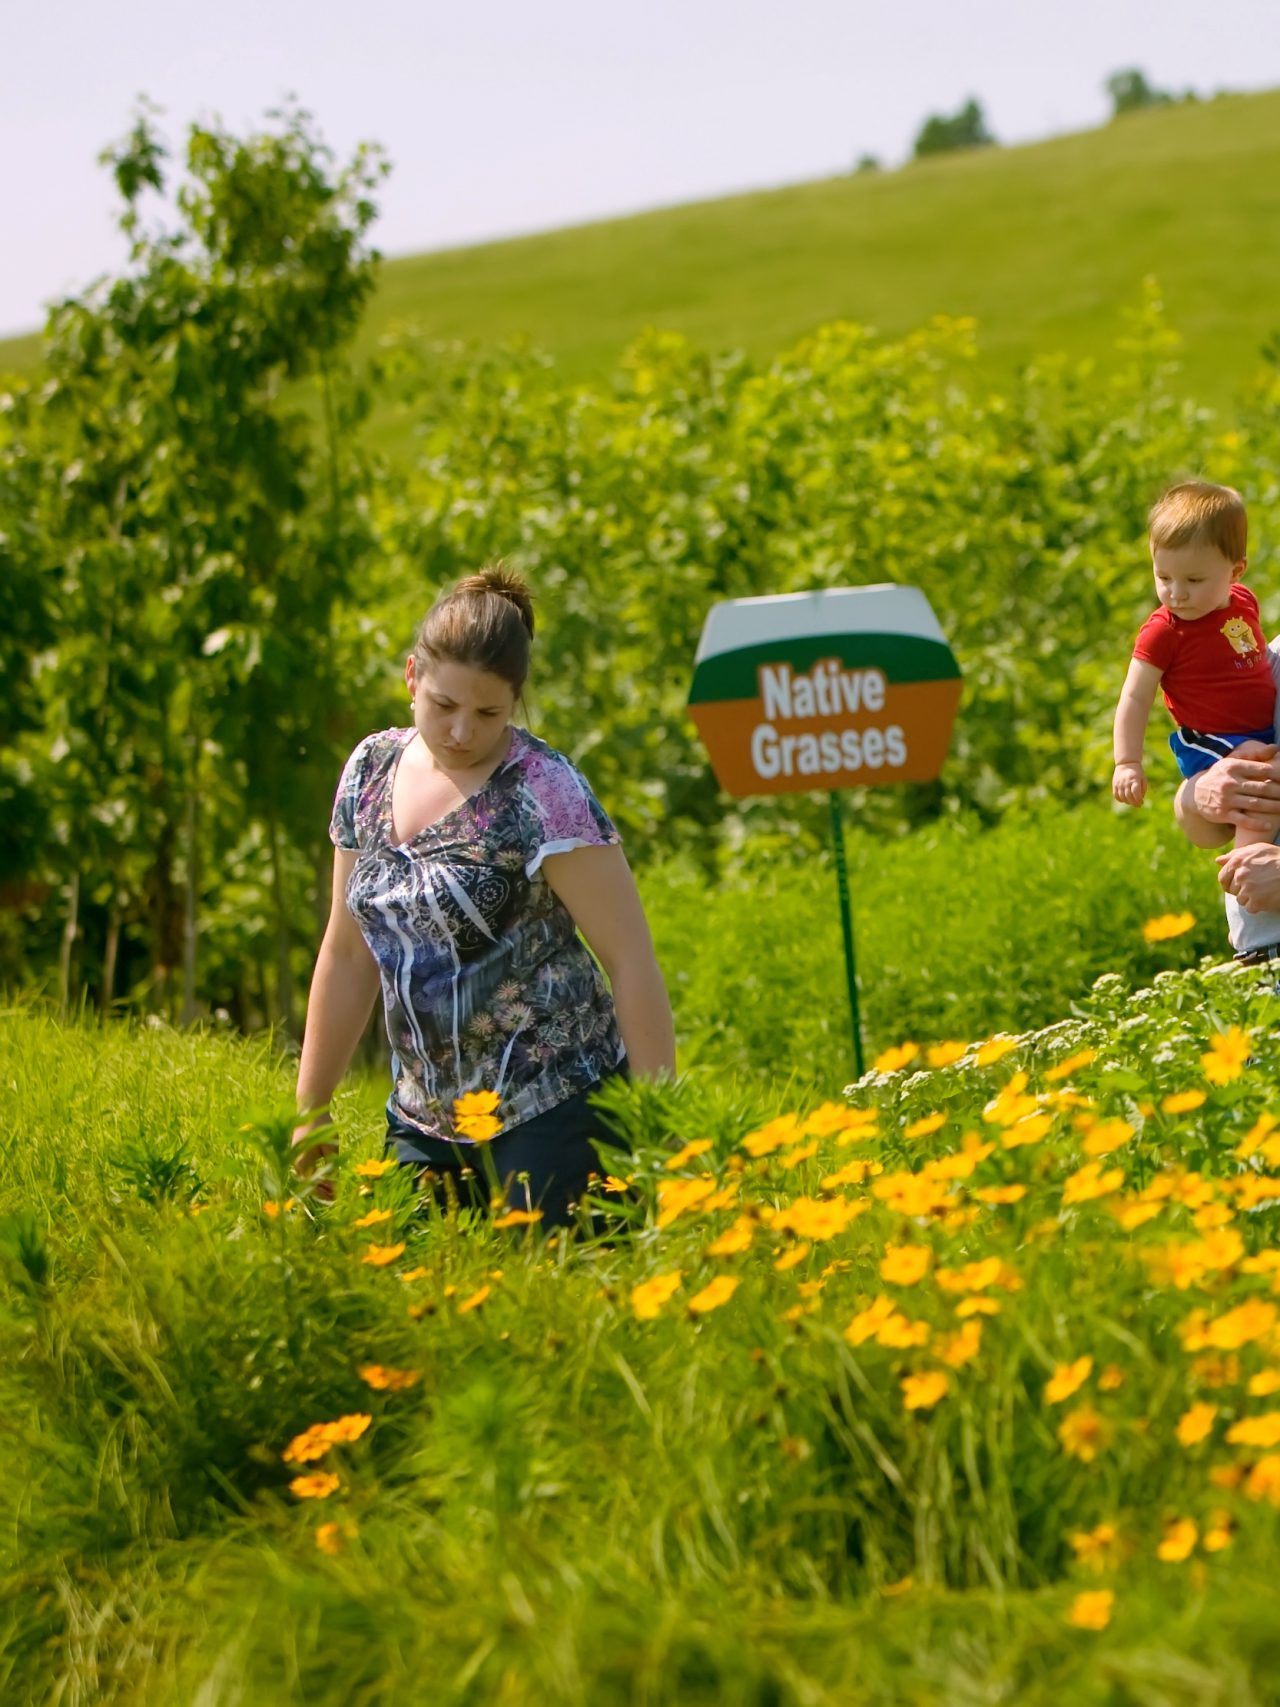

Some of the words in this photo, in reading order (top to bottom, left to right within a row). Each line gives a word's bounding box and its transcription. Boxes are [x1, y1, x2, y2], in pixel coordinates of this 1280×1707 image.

[761, 661, 885, 719] Native
[1234, 658, 1254, 669] hg
[752, 724, 906, 778] Grasses
